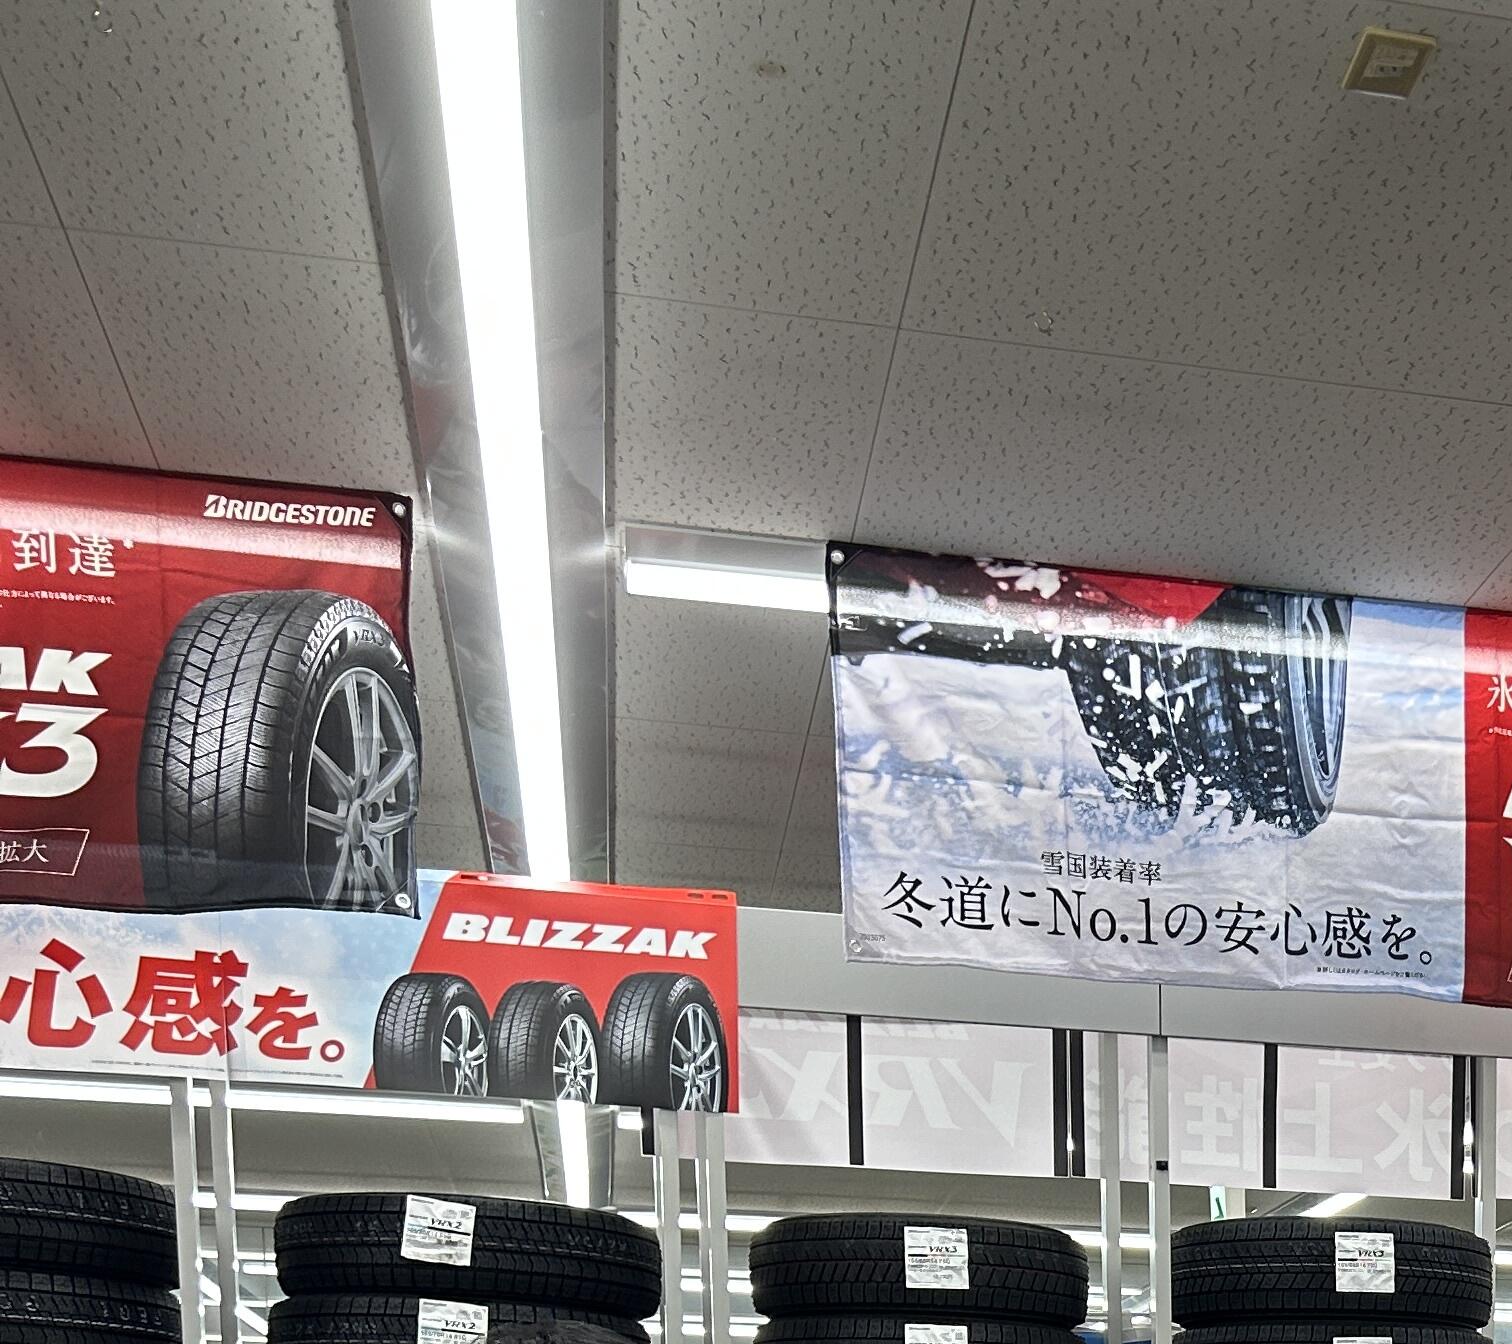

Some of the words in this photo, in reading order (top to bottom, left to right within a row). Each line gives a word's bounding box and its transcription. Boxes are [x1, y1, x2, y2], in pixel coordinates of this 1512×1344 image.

[203, 494, 376, 527] BRIDGESTONE
[0, 702, 109, 798] 3
[1041, 851, 1162, 886] 雪国装着率
[442, 912, 717, 960] BLIZZAK
[882, 872, 1432, 966] 冬道にNo.1の安心感を。
